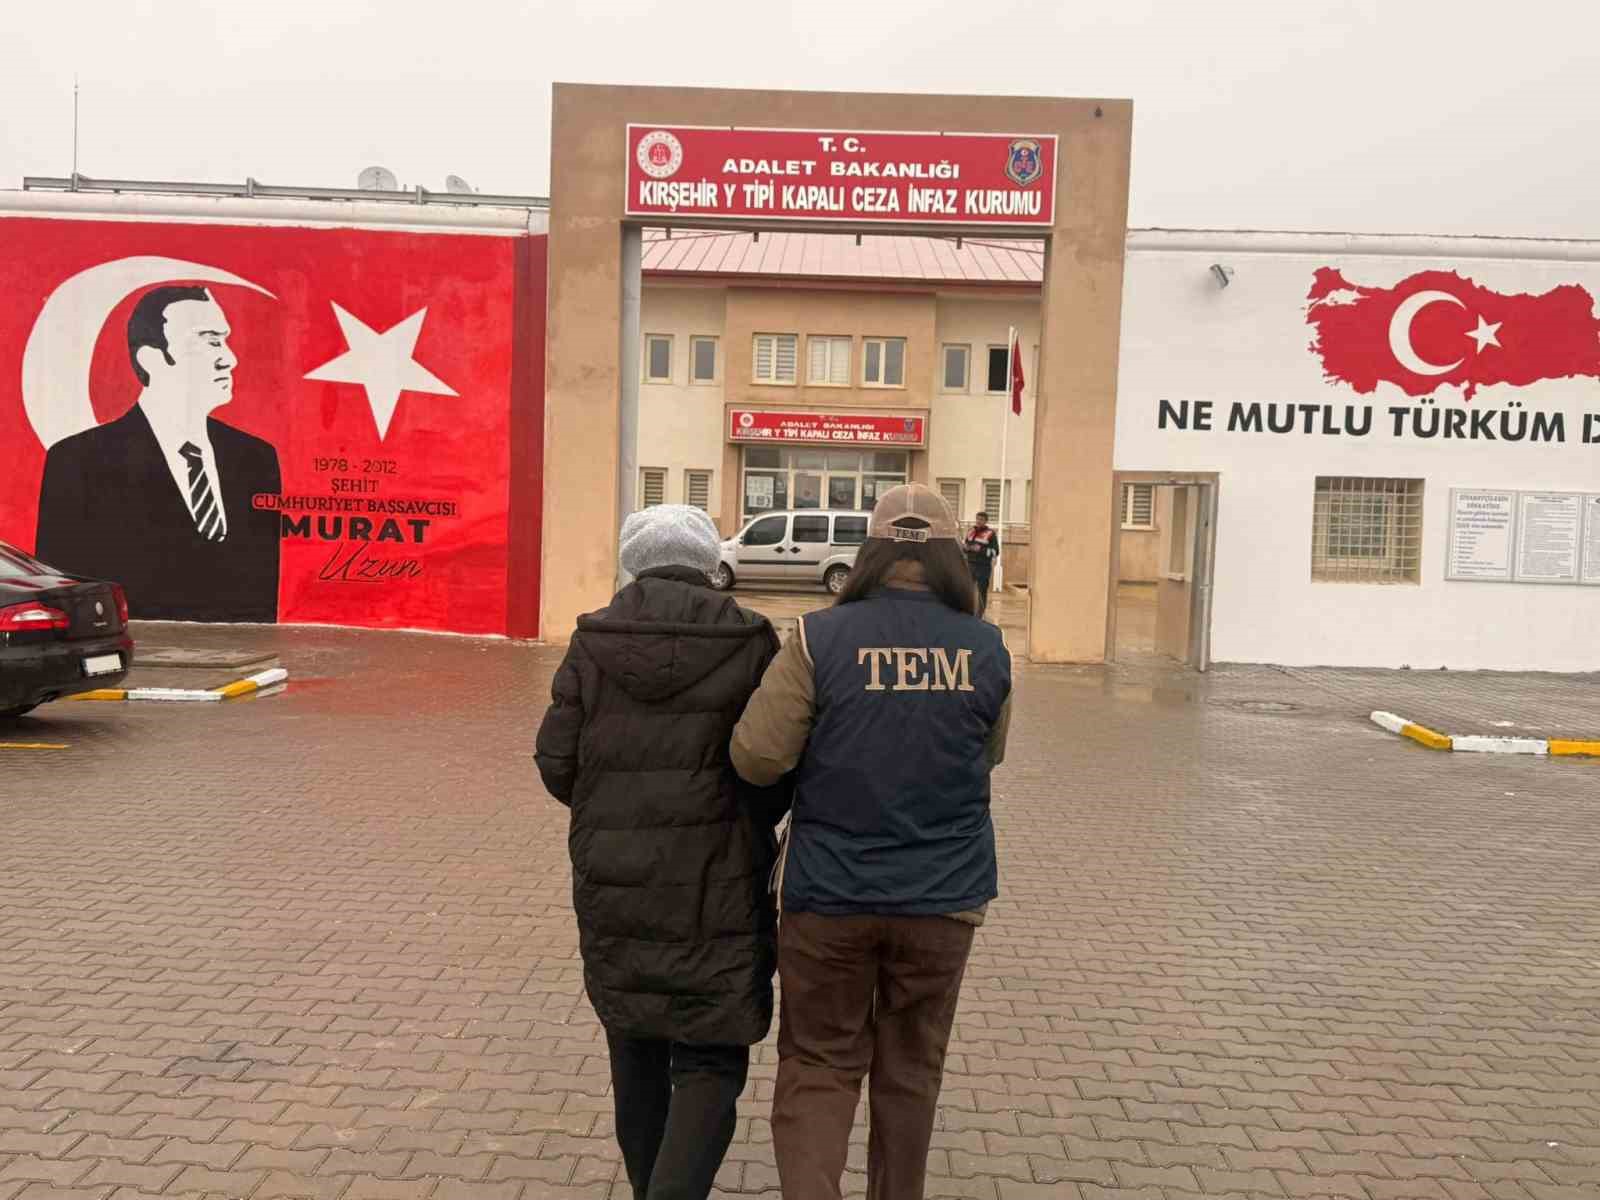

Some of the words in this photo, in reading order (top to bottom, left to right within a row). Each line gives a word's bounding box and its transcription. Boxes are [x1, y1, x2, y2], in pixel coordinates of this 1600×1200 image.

[818, 137, 836, 152] T.
[843, 138, 866, 153] C.
[722, 158, 816, 175] ADALET
[830, 160, 960, 179] BAKANLIĞI
[639, 177, 718, 212] KIRŞEHİR
[724, 184, 736, 208] Y
[743, 179, 774, 209] TİPİ
[782, 185, 844, 211] KAPALI
[852, 187, 900, 212] CEZA
[908, 183, 958, 214] İNFAZ
[965, 190, 1042, 215] KURUMU
[1158, 399, 1213, 431] NE
[1227, 402, 1373, 436] MUTLU
[1388, 398, 1566, 442] TÜRKÜM
[800, 429, 830, 439] KAPALI
[832, 430, 854, 440] CEZA
[314, 457, 348, 473] 1978
[363, 459, 397, 474] 2012
[331, 477, 380, 494] ŞEHİT
[252, 493, 364, 512] CUMHURİYET
[367, 499, 456, 516] BAŞSAVCISI
[281, 515, 431, 543] MURAT
[319, 542, 422, 581] Uzun
[858, 647, 976, 691] TEM
